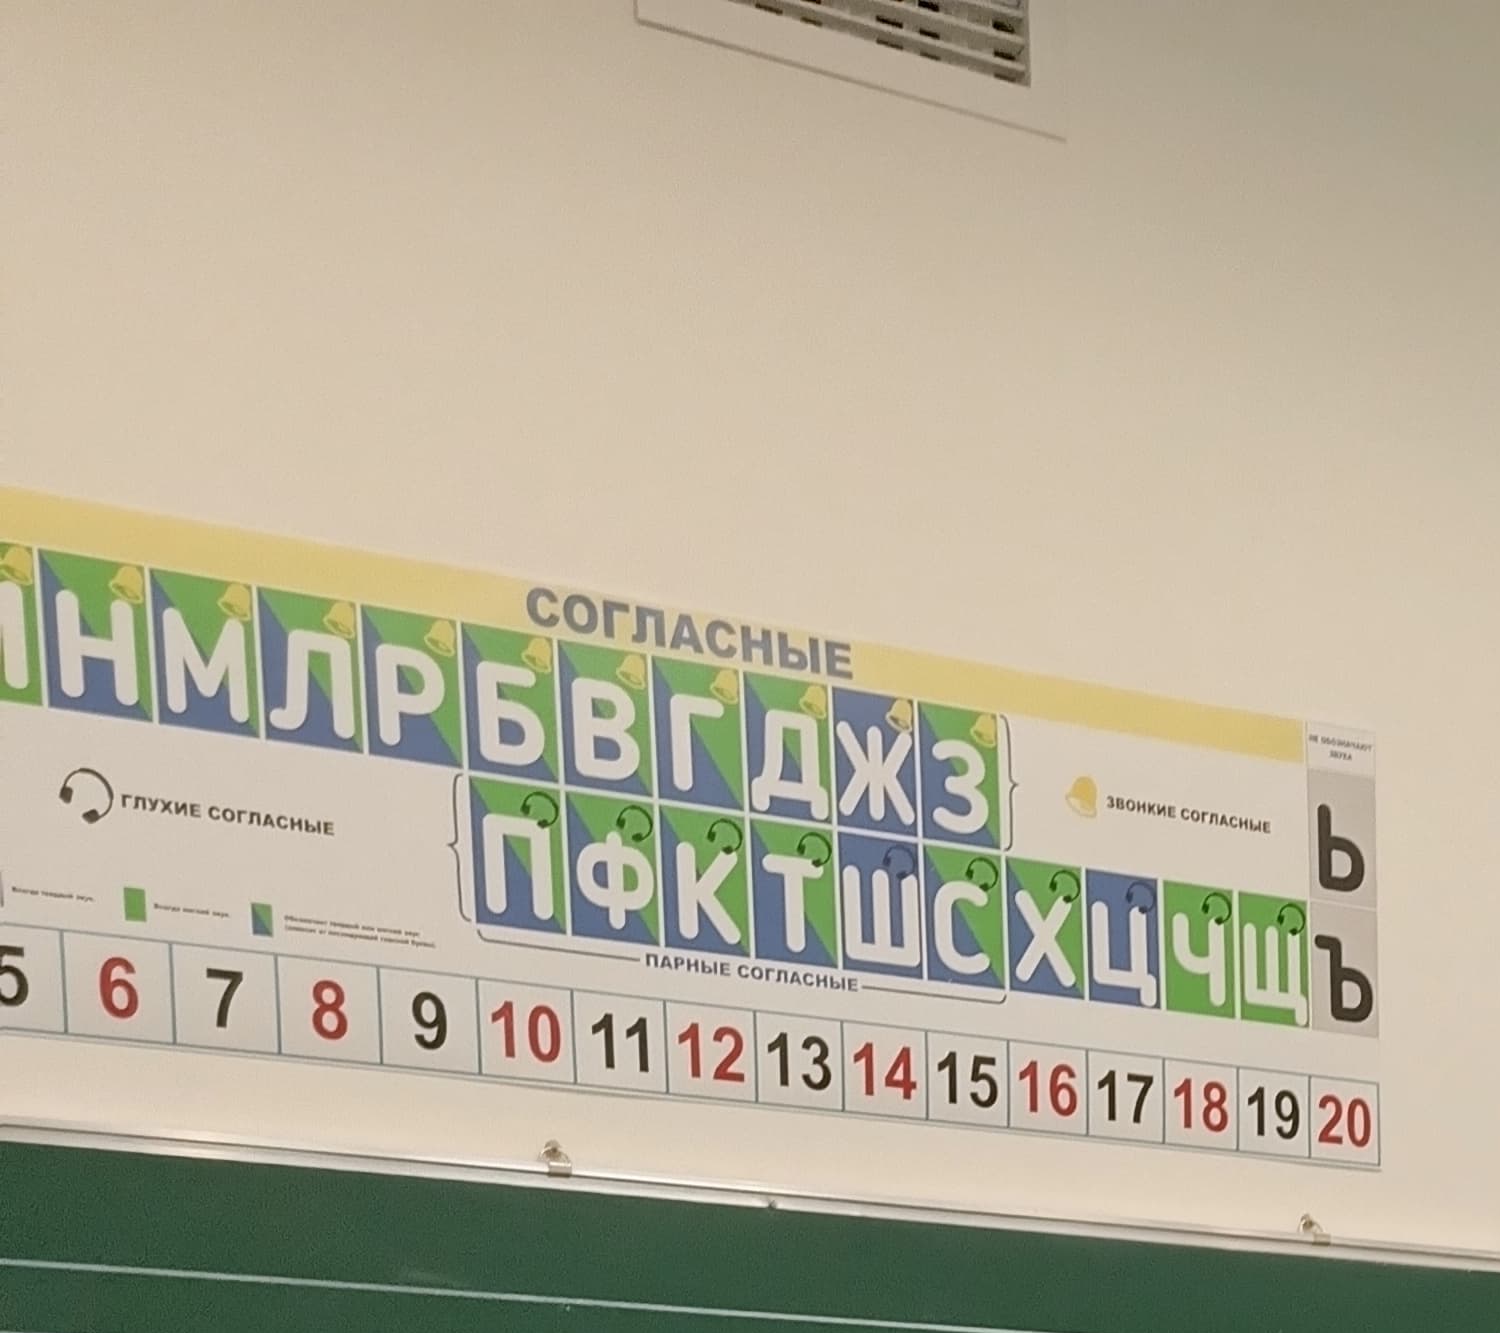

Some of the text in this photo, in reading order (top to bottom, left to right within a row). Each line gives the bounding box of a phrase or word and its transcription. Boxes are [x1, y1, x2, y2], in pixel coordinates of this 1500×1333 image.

[526, 587, 854, 680] СОГЛАСНЫЕ
[55, 590, 139, 706] Н
[162, 607, 249, 723] М
[269, 629, 355, 739] Л
[375, 643, 445, 746] Р
[475, 659, 545, 766] Б
[571, 677, 640, 780] В
[669, 693, 724, 791] Г
[751, 709, 829, 820] Д
[836, 720, 915, 825] Ж
[932, 740, 989, 834] З
[121, 794, 335, 836] ГЛУХИЕ СОГЛАСНЫЕ
[1106, 795, 1272, 834] ЗВОНКИЕ СОГЛАСНЫЕ
[1317, 804, 1365, 892] Ь
[482, 813, 1308, 1026] П Ф К Т Ш С Х Ц Ч Щ
[645, 953, 859, 992] ПАРНЫЕ СОГЛАСНЫЕ
[1314, 934, 1373, 1023] Ъ
[99, 957, 139, 1019] 6
[206, 968, 243, 1028] 7
[311, 980, 348, 1040] 8
[412, 991, 447, 1050] 9
[490, 1000, 561, 1063] 10
[591, 1012, 650, 1073] 11
[678, 1024, 745, 1082] 12
[767, 1031, 832, 1091] 13
[853, 1041, 917, 1099] 14
[937, 1050, 998, 1108] 15
[1018, 1058, 1077, 1116] 16
[1097, 1069, 1154, 1124] 17
[1173, 1076, 1228, 1132] 18
[1247, 1086, 1300, 1140] 19
[1318, 1094, 1371, 1147] 20
